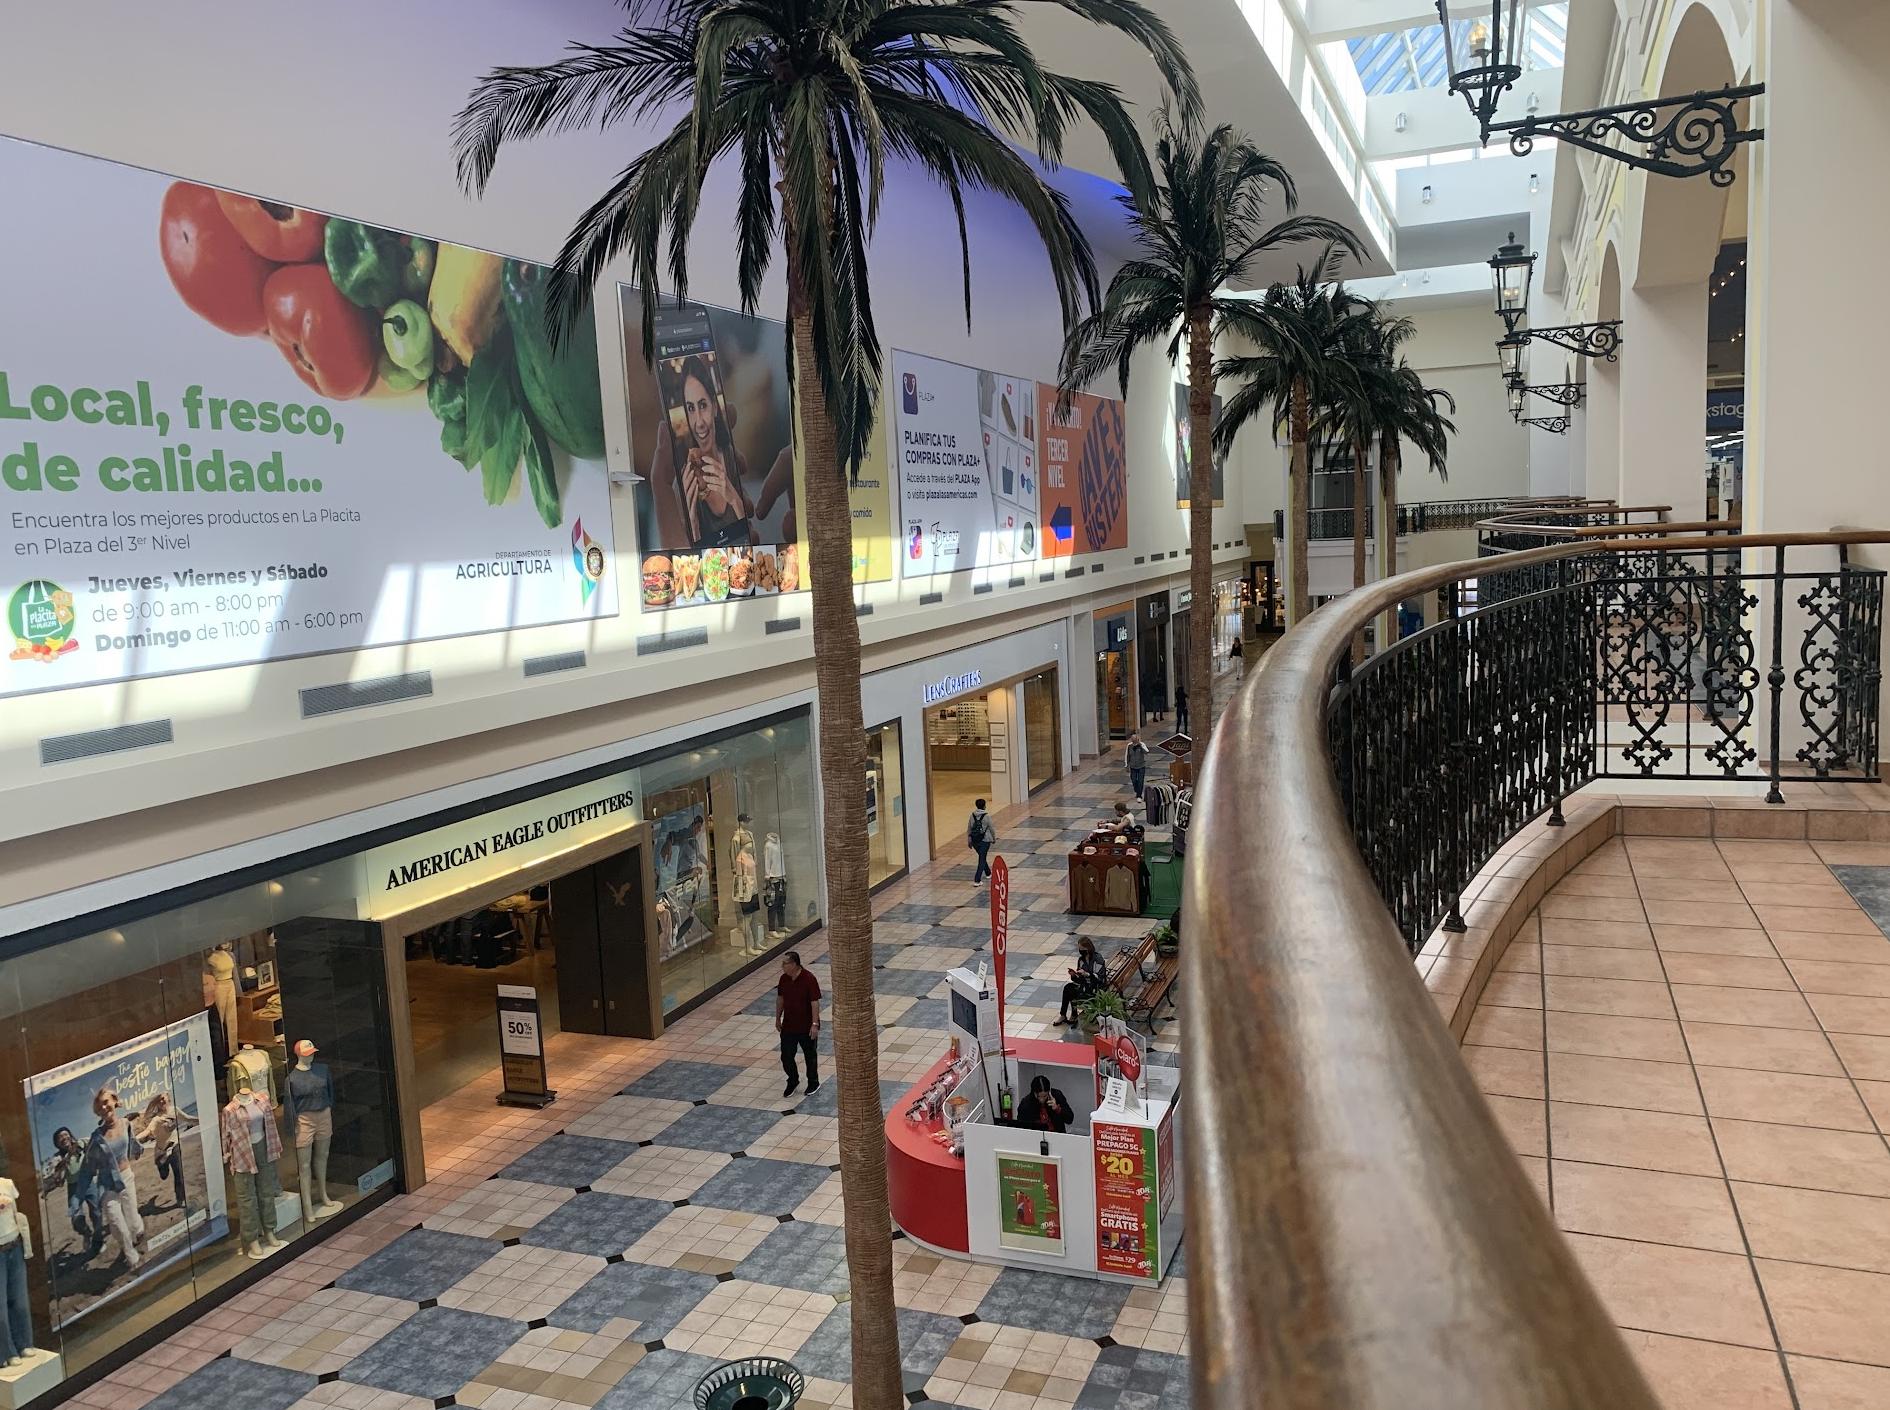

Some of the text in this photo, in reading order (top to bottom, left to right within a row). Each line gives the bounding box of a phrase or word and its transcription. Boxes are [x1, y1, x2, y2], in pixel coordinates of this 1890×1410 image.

[0, 371, 344, 444] Local, fresco,
[904, 430, 956, 448] PLANIFICA TUS
[1046, 437, 1068, 462] TERCER
[2, 442, 322, 492] de calidad...
[905, 450, 980, 467] COMPRAS CON PLAZA+
[906, 472, 926, 483] Accede
[927, 475, 931, 483] a
[955, 474, 971, 483] PLAZA
[971, 474, 981, 486] App
[12, 507, 361, 530] Encuentra los mejores productos en La Placita
[14, 540, 38, 555] en
[45, 537, 92, 554] Plaza
[97, 536, 123, 553] del
[152, 534, 191, 550] Nivel
[495, 550, 541, 559] DEPARTAMENTO
[88, 562, 328, 594] Jueves, Viernes y Sábado
[456, 559, 552, 580] AGRICULTURA
[92, 604, 118, 622] de
[123, 600, 165, 619] 9:00
[170, 600, 199, 617] am
[215, 593, 252, 611] 8:00
[257, 593, 284, 613] pm
[95, 627, 191, 652] Domingo
[196, 623, 218, 640] de
[222, 619, 260, 638] 11:00
[265, 618, 290, 634] am
[304, 611, 336, 629] 6:00
[339, 611, 363, 629] pm
[385, 790, 634, 890] AMERICAN EAGLE OUTFITTERS
[996, 878, 1007, 955] Claro
[1117, 1048, 1137, 1068] Claro
[1096, 1139, 1129, 1149] PREPAGO
[1129, 1143, 1139, 1151] 5G
[1100, 1133, 1134, 1143] Mejor Plan
[1100, 1154, 1134, 1176] $20
[1100, 1211, 1138, 1222] Smartphone
[1100, 1218, 1139, 1232] GRATIS
